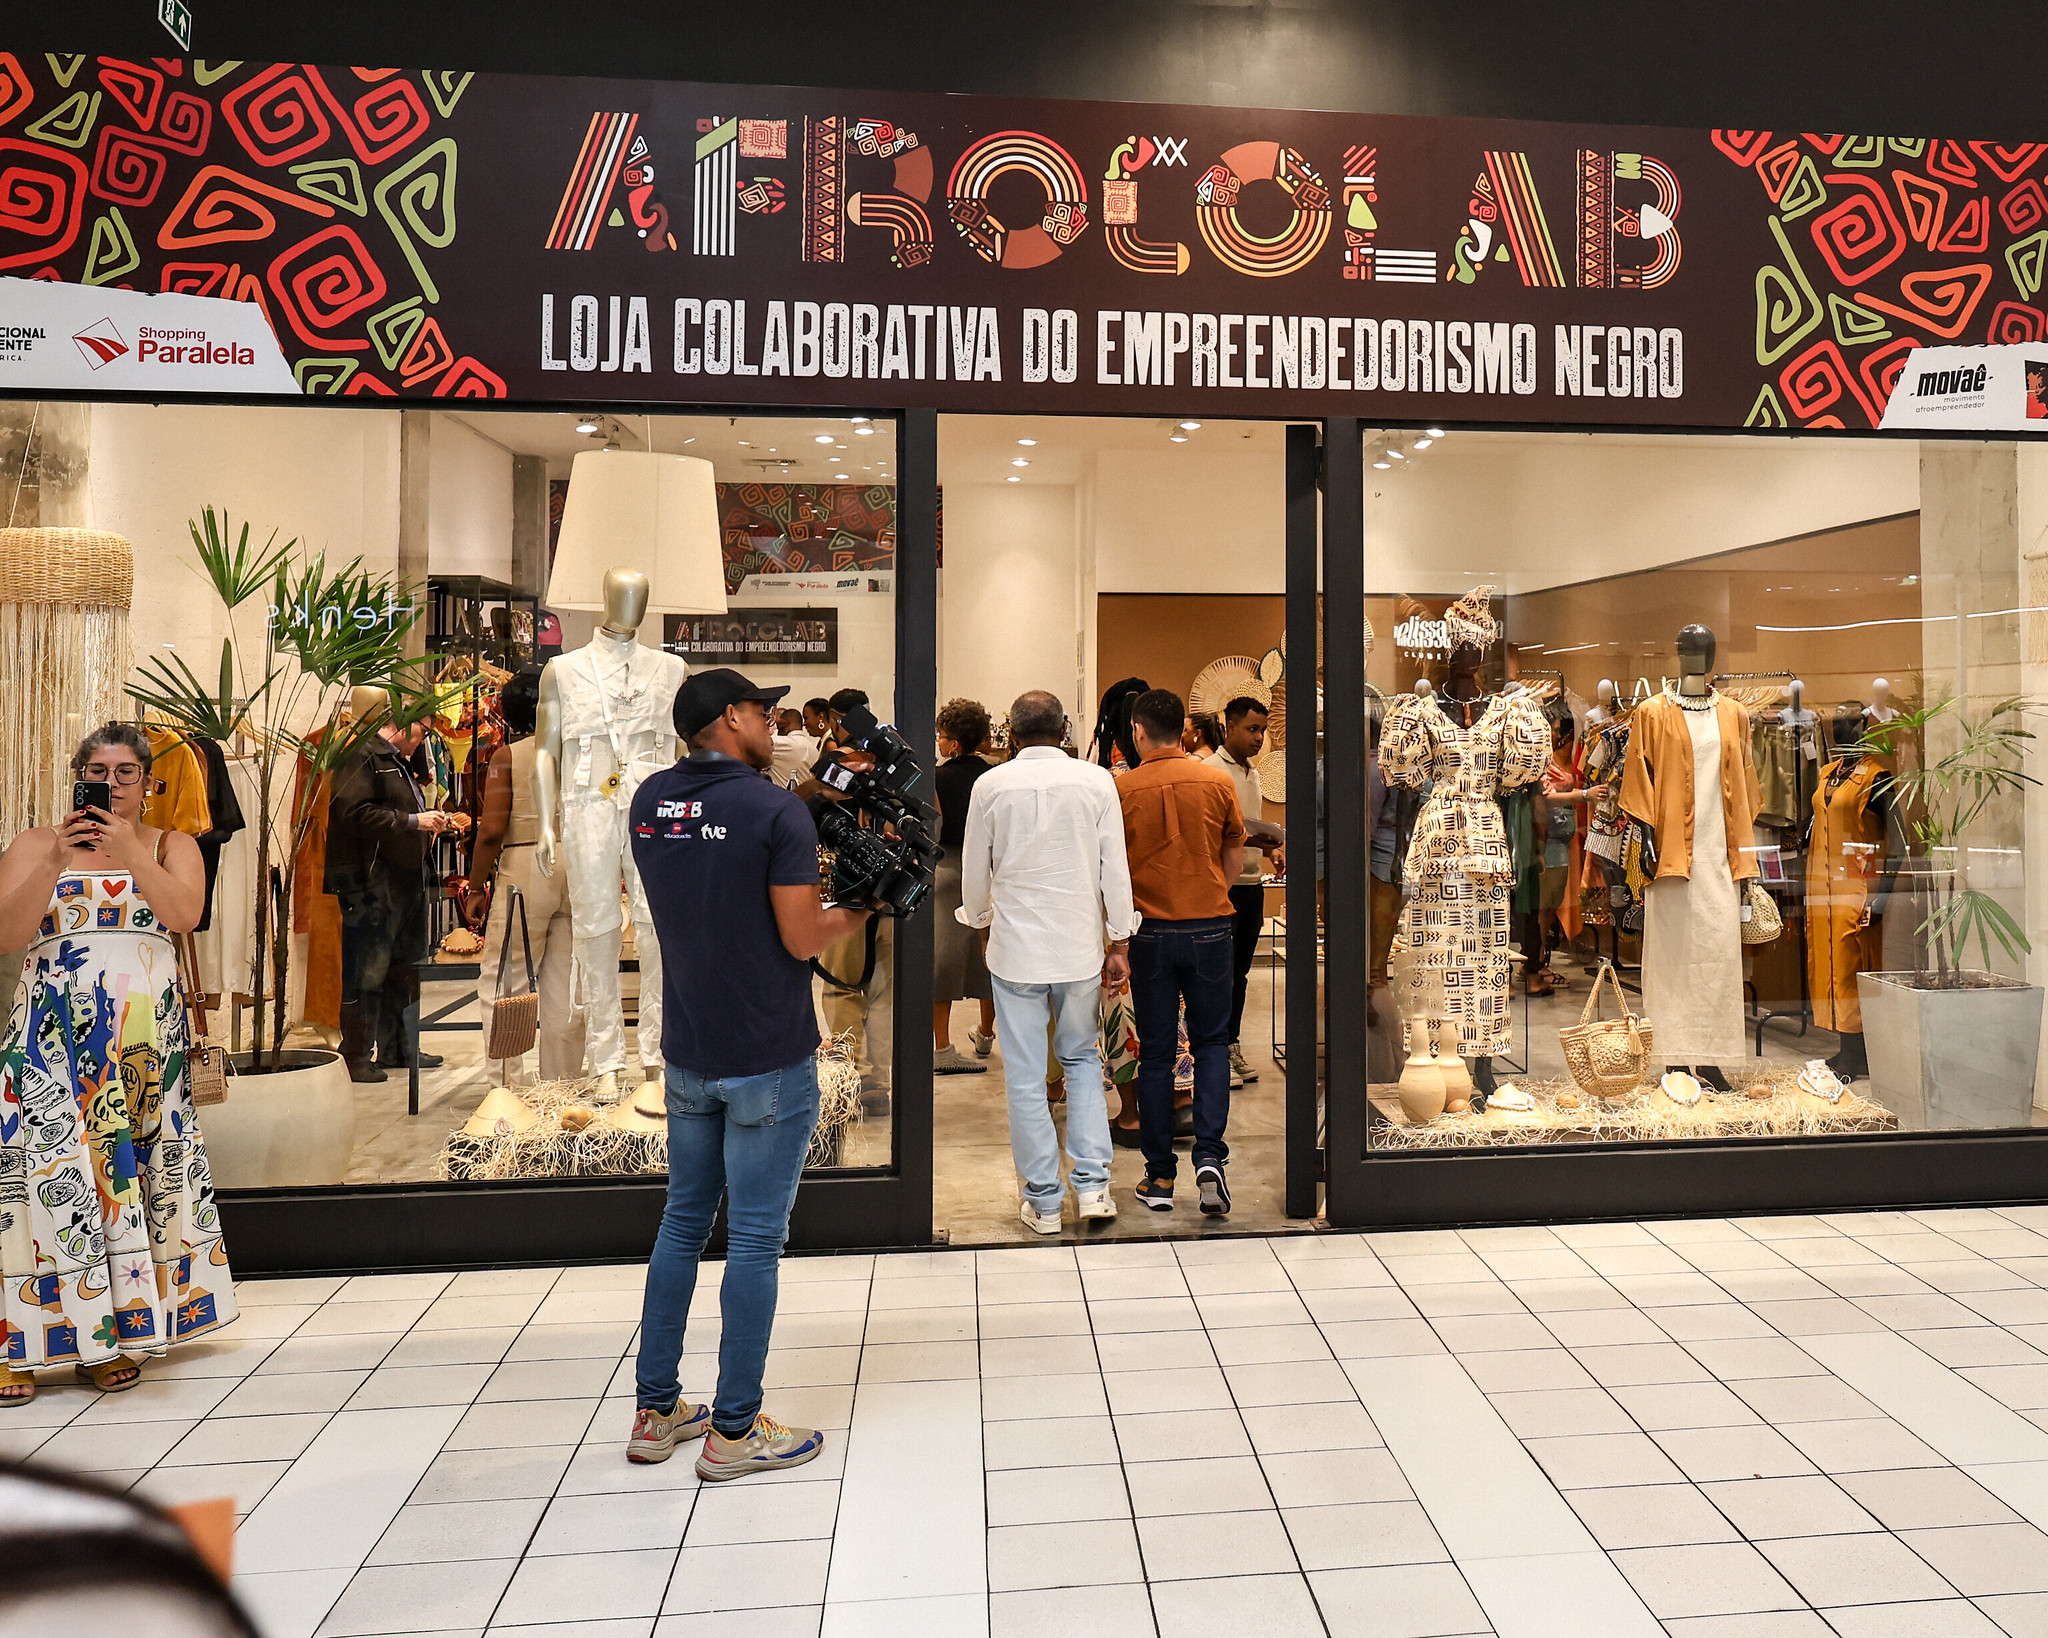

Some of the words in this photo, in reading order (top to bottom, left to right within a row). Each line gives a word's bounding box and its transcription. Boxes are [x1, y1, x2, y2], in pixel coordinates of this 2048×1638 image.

[544, 112, 1683, 289] AFROCOLAB
[139, 327, 206, 342] Shopping
[541, 293, 652, 373] LOJA
[673, 298, 1002, 383] COLABORATIVA
[1022, 308, 1078, 384] DO
[1096, 311, 1537, 396] EMPREENDEDORISMO
[1554, 324, 1684, 399] NEGRO
[138, 340, 255, 365] Paralela
[1916, 364, 1987, 397] movaê
[1915, 402, 1986, 413] afroempreendedor
[1943, 394, 1986, 403] movimento
